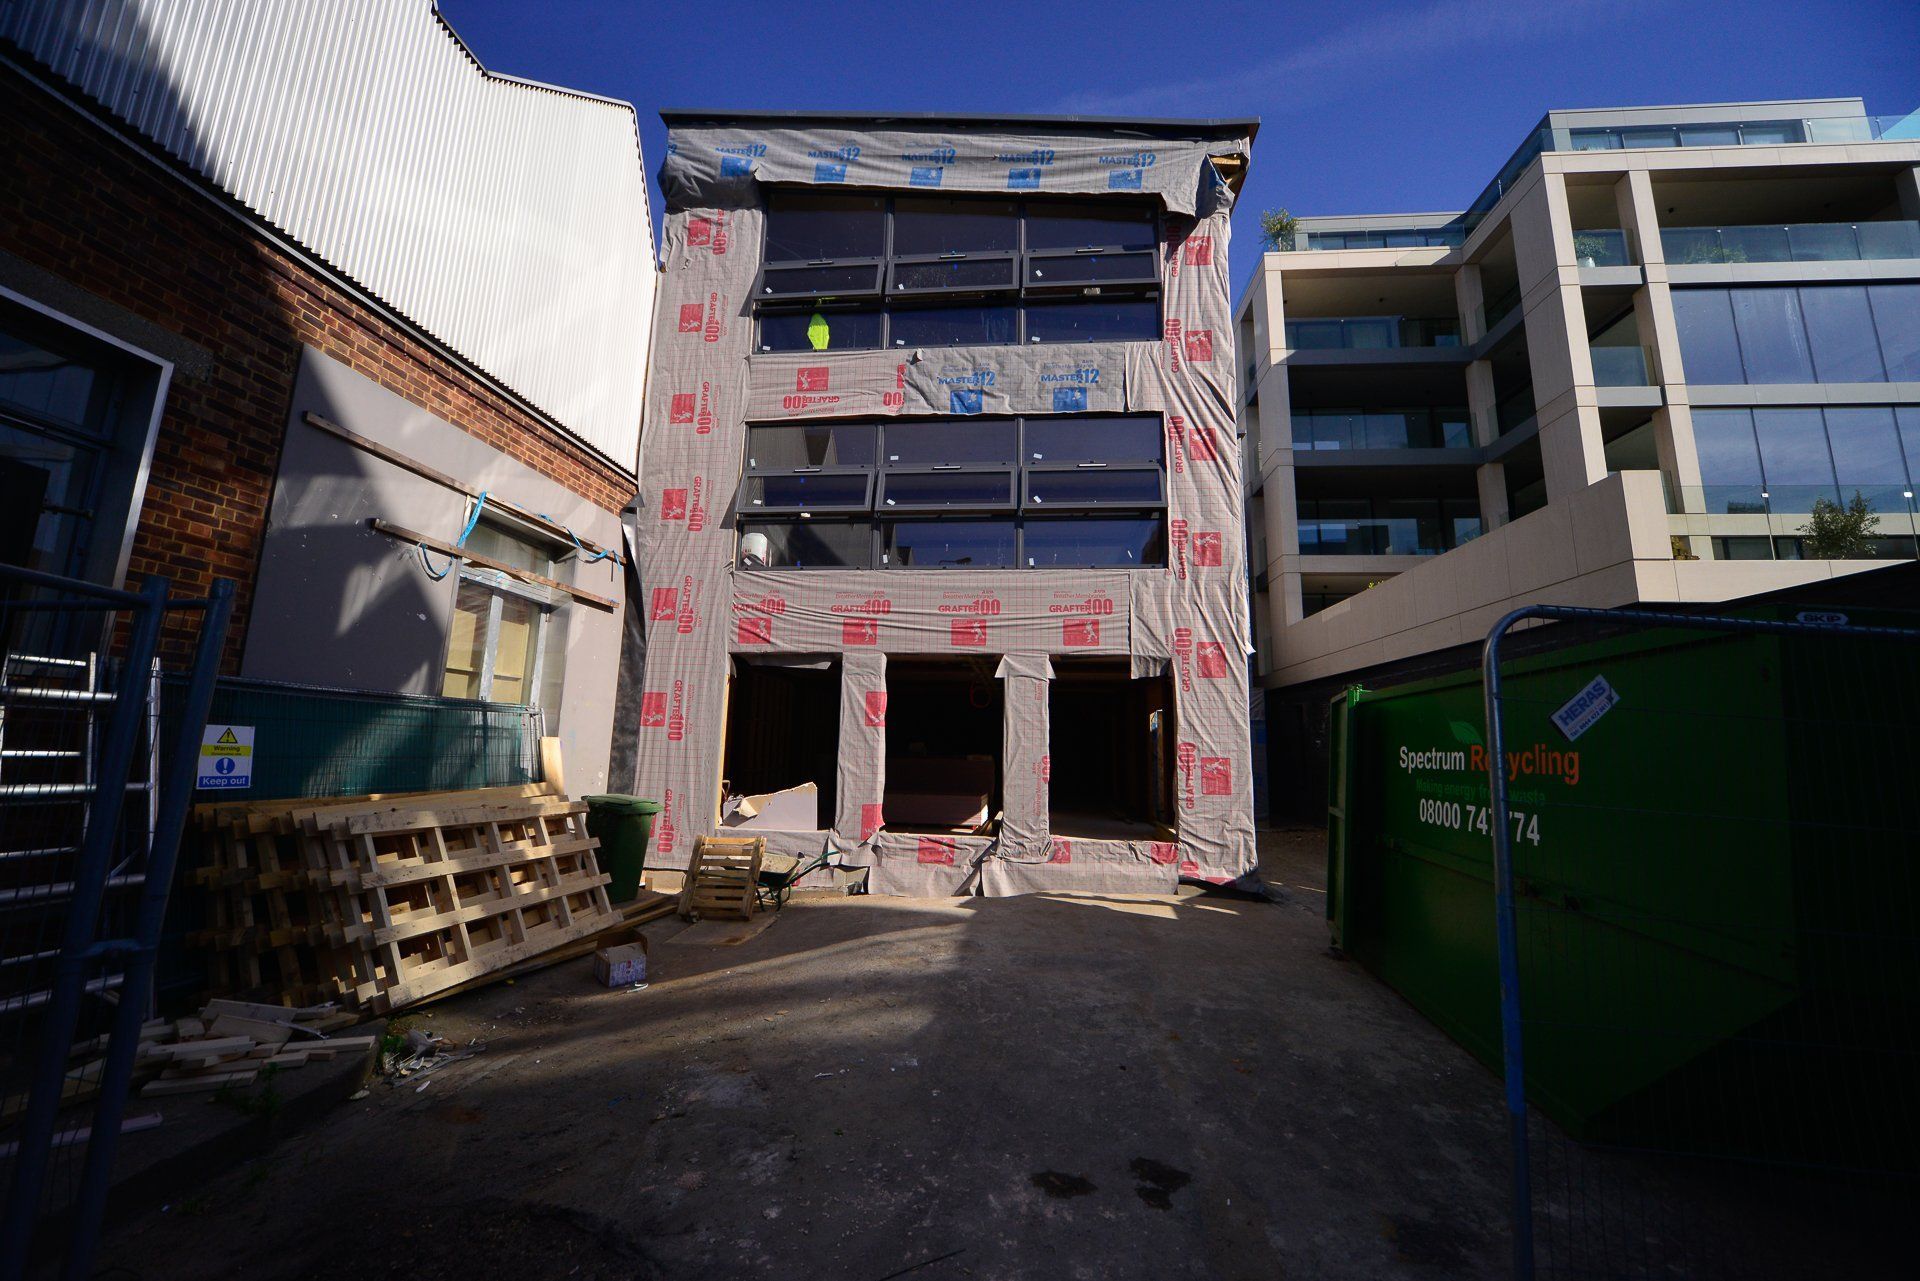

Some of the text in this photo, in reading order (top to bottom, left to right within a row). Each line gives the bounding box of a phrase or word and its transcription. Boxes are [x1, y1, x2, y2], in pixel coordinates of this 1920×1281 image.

[1558, 680, 1607, 726] HERAS
[202, 776, 246, 787] Keep out
[1400, 744, 1580, 785] Spectrum Rycling
[1420, 798, 1540, 846] 08000 7474
